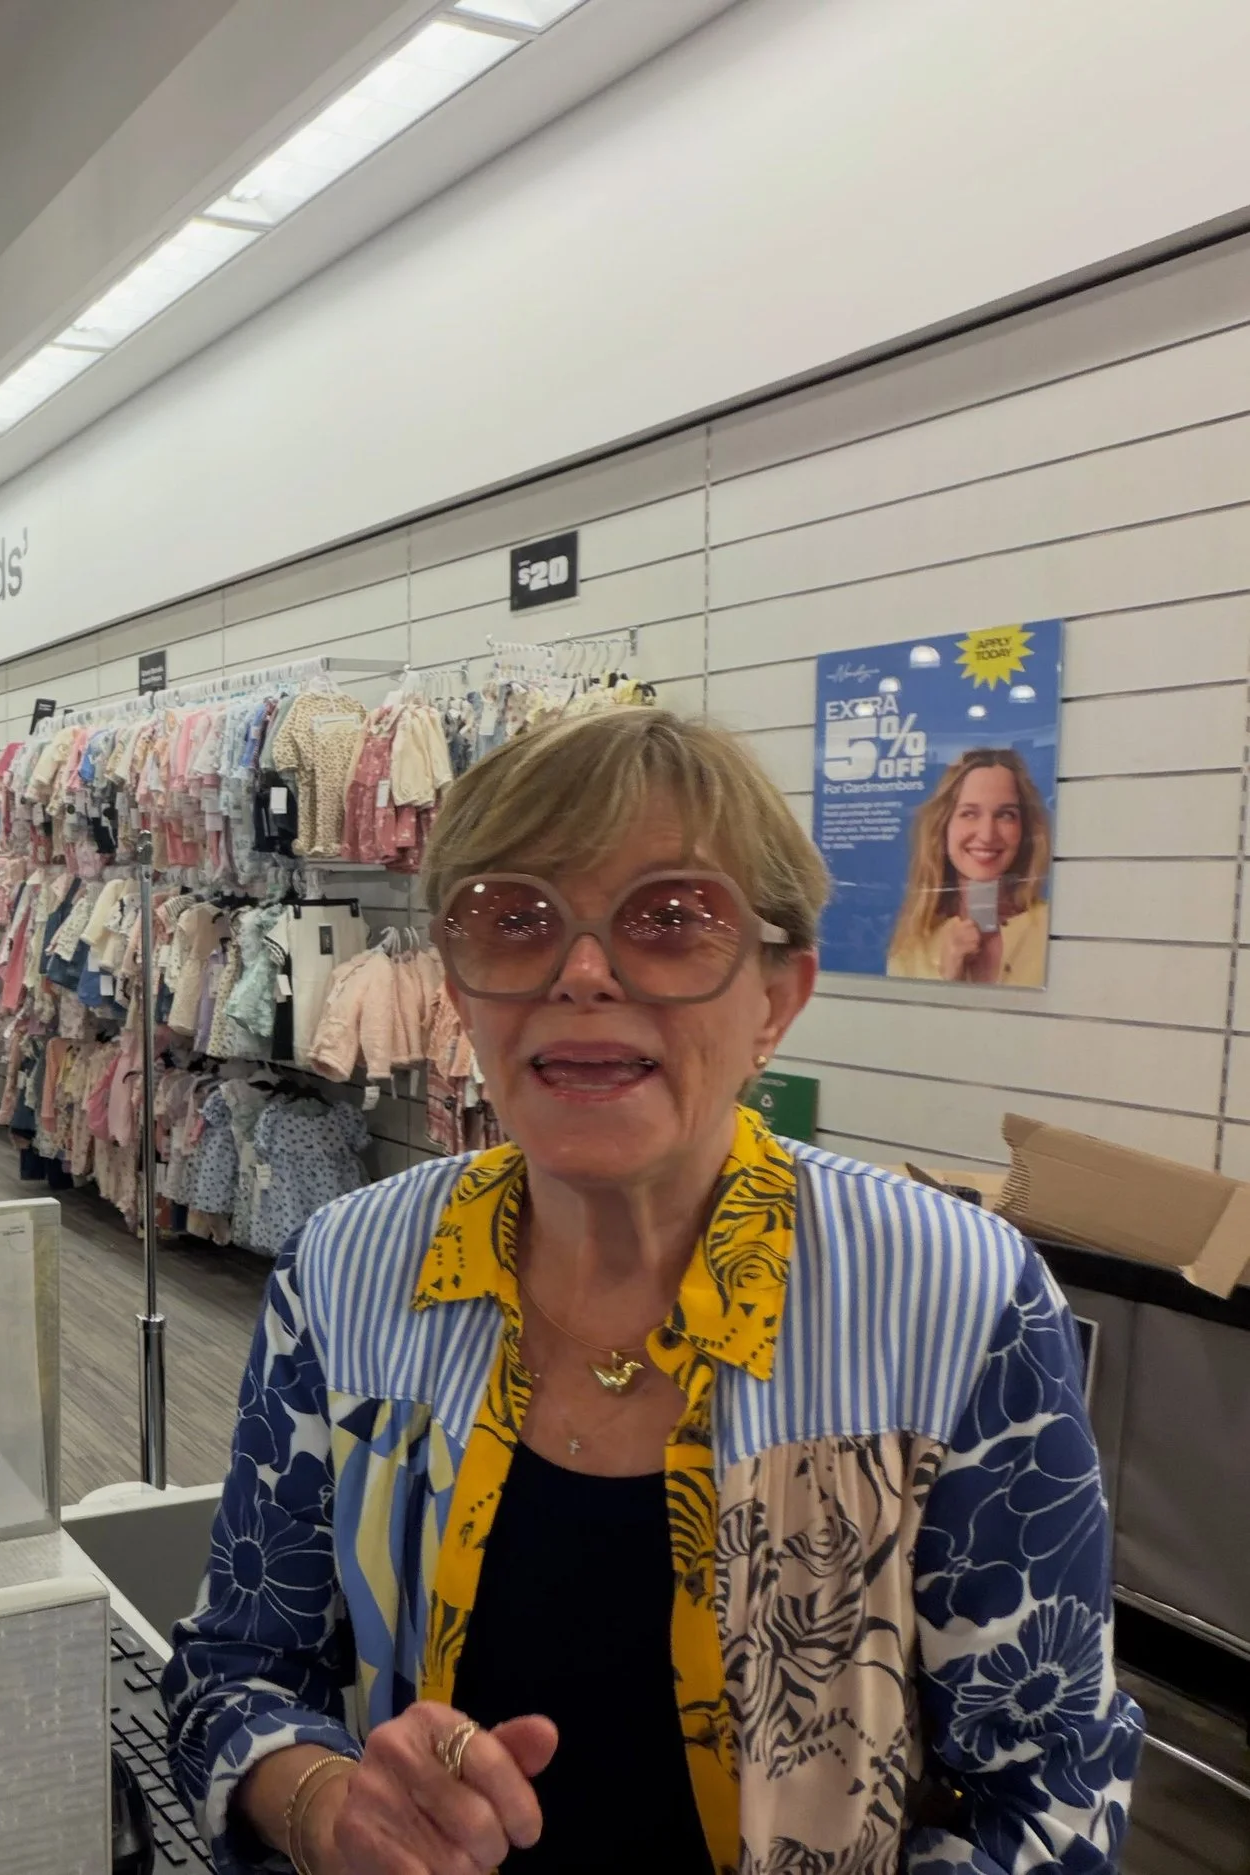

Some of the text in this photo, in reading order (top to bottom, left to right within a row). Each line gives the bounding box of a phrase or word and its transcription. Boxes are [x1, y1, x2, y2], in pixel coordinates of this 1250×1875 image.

[977, 635, 1012, 649] APPLY
[975, 648, 1012, 661] TODAY
[823, 713, 927, 781] 5%
[877, 757, 926, 778] OFF
